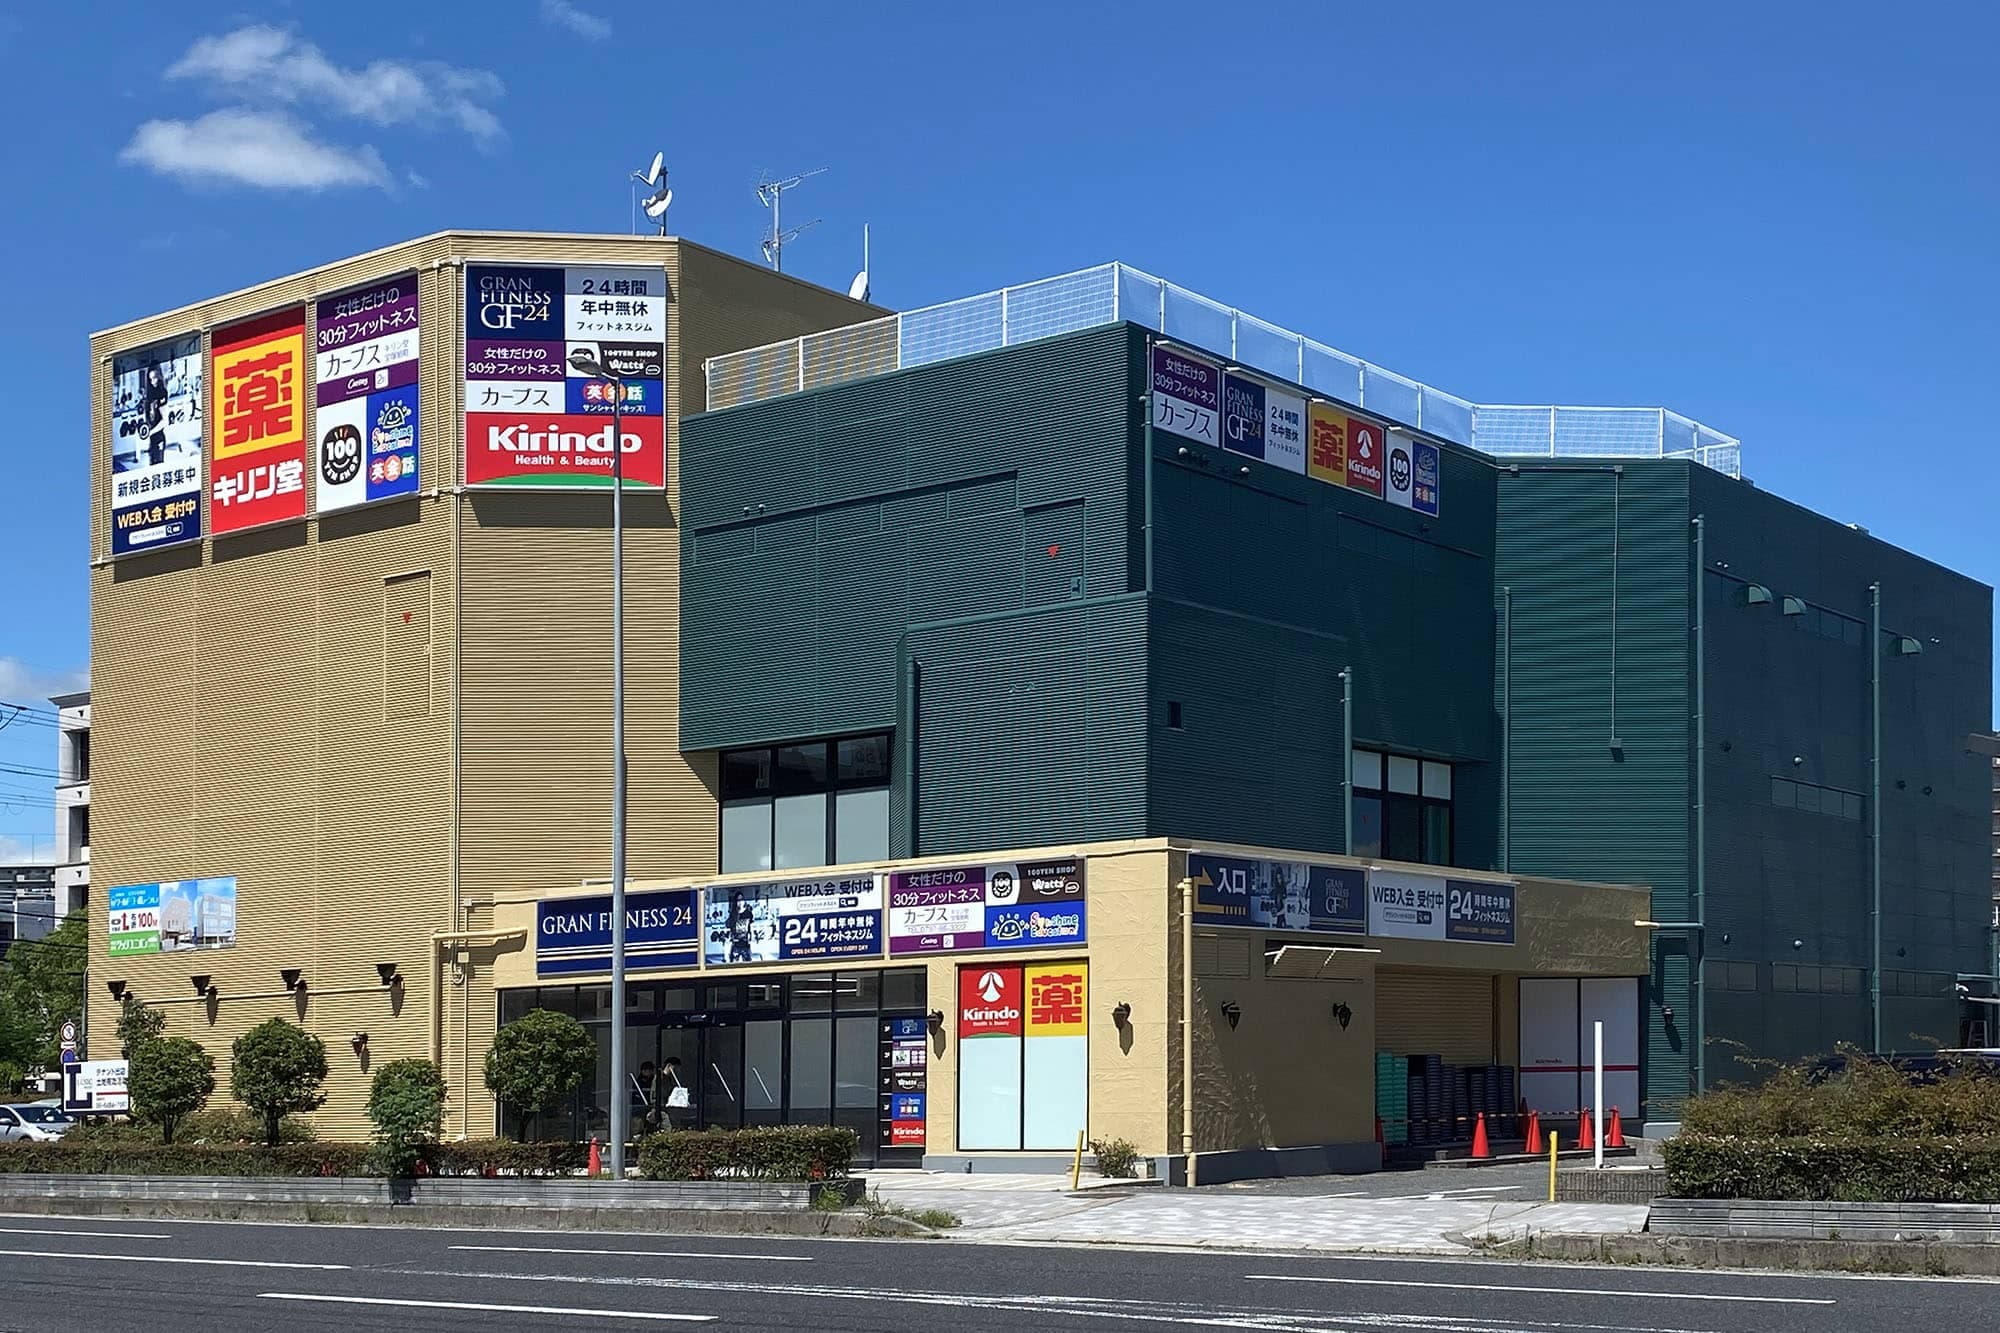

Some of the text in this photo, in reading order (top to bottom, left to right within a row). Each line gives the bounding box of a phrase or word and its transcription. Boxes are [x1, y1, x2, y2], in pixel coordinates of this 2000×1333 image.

[480, 276, 532, 290] GRAN
[582, 279, 648, 296] 24時間
[334, 288, 399, 320] 女性だけの
[480, 290, 551, 304] FITNESS
[581, 300, 648, 316] 年中無休
[319, 307, 416, 346] 30分フィットネス
[480, 303, 550, 329] GF24
[576, 321, 652, 332] フィットネスジム
[484, 347, 547, 360] 女性だけの
[468, 362, 562, 375] 30分フィットネス
[1166, 358, 1207, 383] 女性だけの
[224, 351, 292, 447] 薬
[481, 386, 550, 406] カーブス
[1227, 386, 1254, 406] GRAN
[1227, 400, 1263, 423] FITNESS
[327, 437, 357, 460] 100
[488, 424, 642, 452] Kirindo
[1314, 419, 1343, 472] 薬
[515, 454, 616, 468] Health & Beauty
[1348, 459, 1381, 480] Kirindo
[1393, 457, 1408, 474] 100
[118, 466, 196, 497] 新規会員募集中
[213, 458, 303, 506] キリン堂
[117, 499, 196, 529] WEB入会 受付中
[785, 878, 874, 898] WEB入会 受付中
[908, 871, 966, 888] 女性だけの
[1217, 867, 1246, 895] 入口
[893, 888, 980, 905] 30分フィットネス
[1373, 886, 1444, 909] WEB入会 受付中
[1450, 890, 1473, 920] 24
[542, 906, 692, 935] GRAN FINESS 24
[785, 918, 818, 945] 24
[820, 929, 873, 942] フィットネスジム
[1031, 974, 1082, 1024] 薬
[963, 1006, 1019, 1021] Kirindo
[893, 1127, 925, 1136] Kirindo
